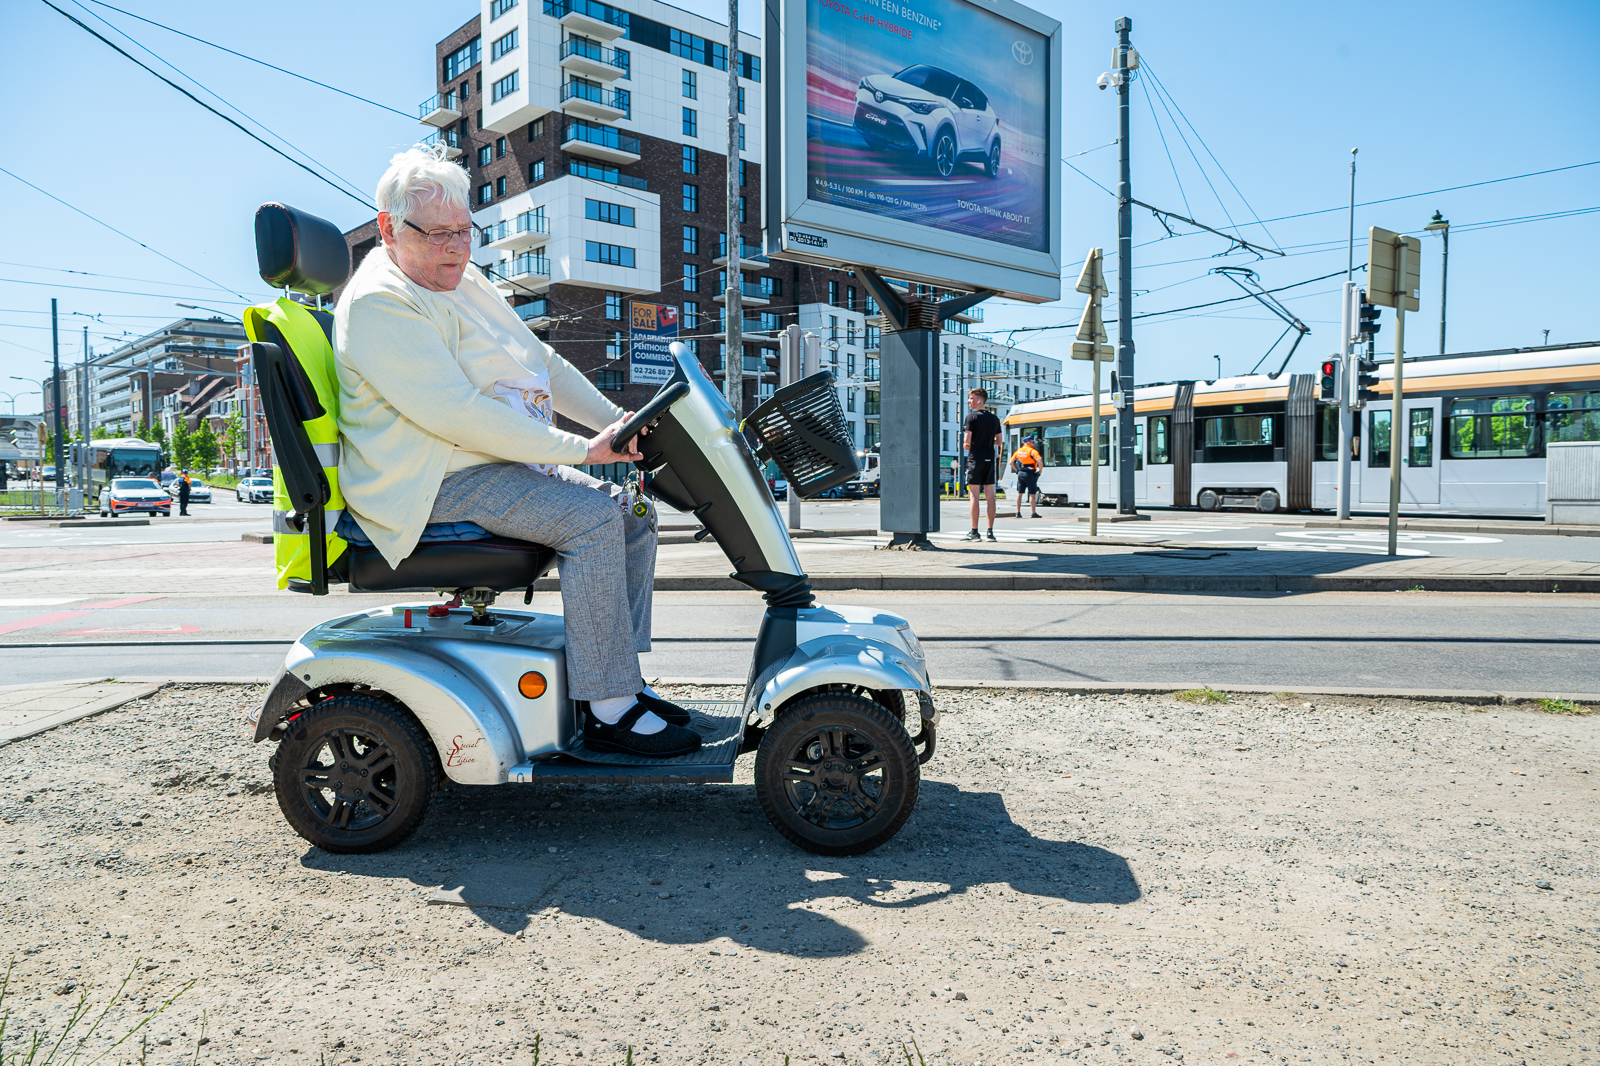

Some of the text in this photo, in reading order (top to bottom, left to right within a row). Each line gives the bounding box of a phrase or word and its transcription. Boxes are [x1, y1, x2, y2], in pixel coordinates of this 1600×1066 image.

[882, 0, 898, 14] EEN
[853, 9, 875, 26] C-HR
[877, 18, 913, 40] HYBRIDE
[984, 206, 1001, 218] THINK
[1002, 212, 1022, 222] ABOUT
[634, 308, 652, 318] FOR
[634, 318, 656, 328] SALE
[446, 735, 484, 754] Special
[446, 749, 475, 767] Edition
